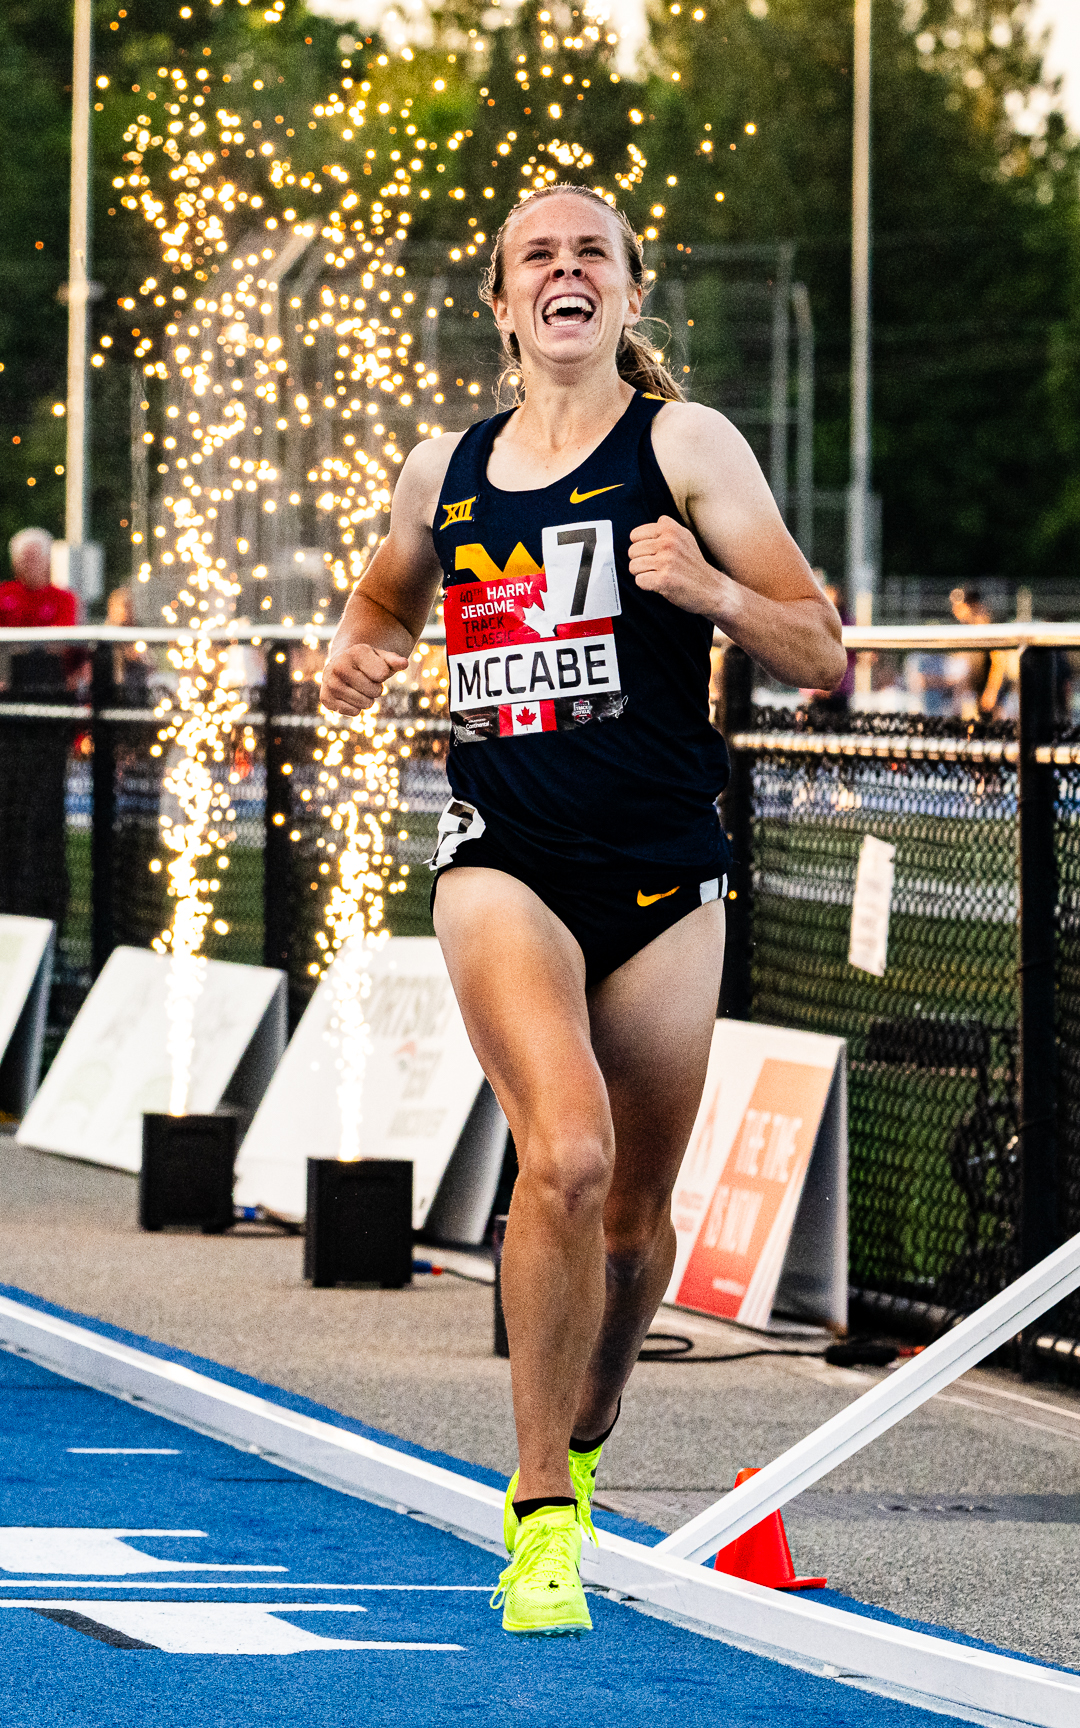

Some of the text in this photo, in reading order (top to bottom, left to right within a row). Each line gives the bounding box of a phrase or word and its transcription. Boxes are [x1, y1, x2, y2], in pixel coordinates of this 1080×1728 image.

[556, 527, 597, 617] 7
[486, 581, 533, 601] HARRY
[461, 599, 515, 620] JEROME
[462, 615, 506, 634] TRACK
[465, 629, 515, 649] CLASSIC
[457, 643, 610, 703] MCCABE
